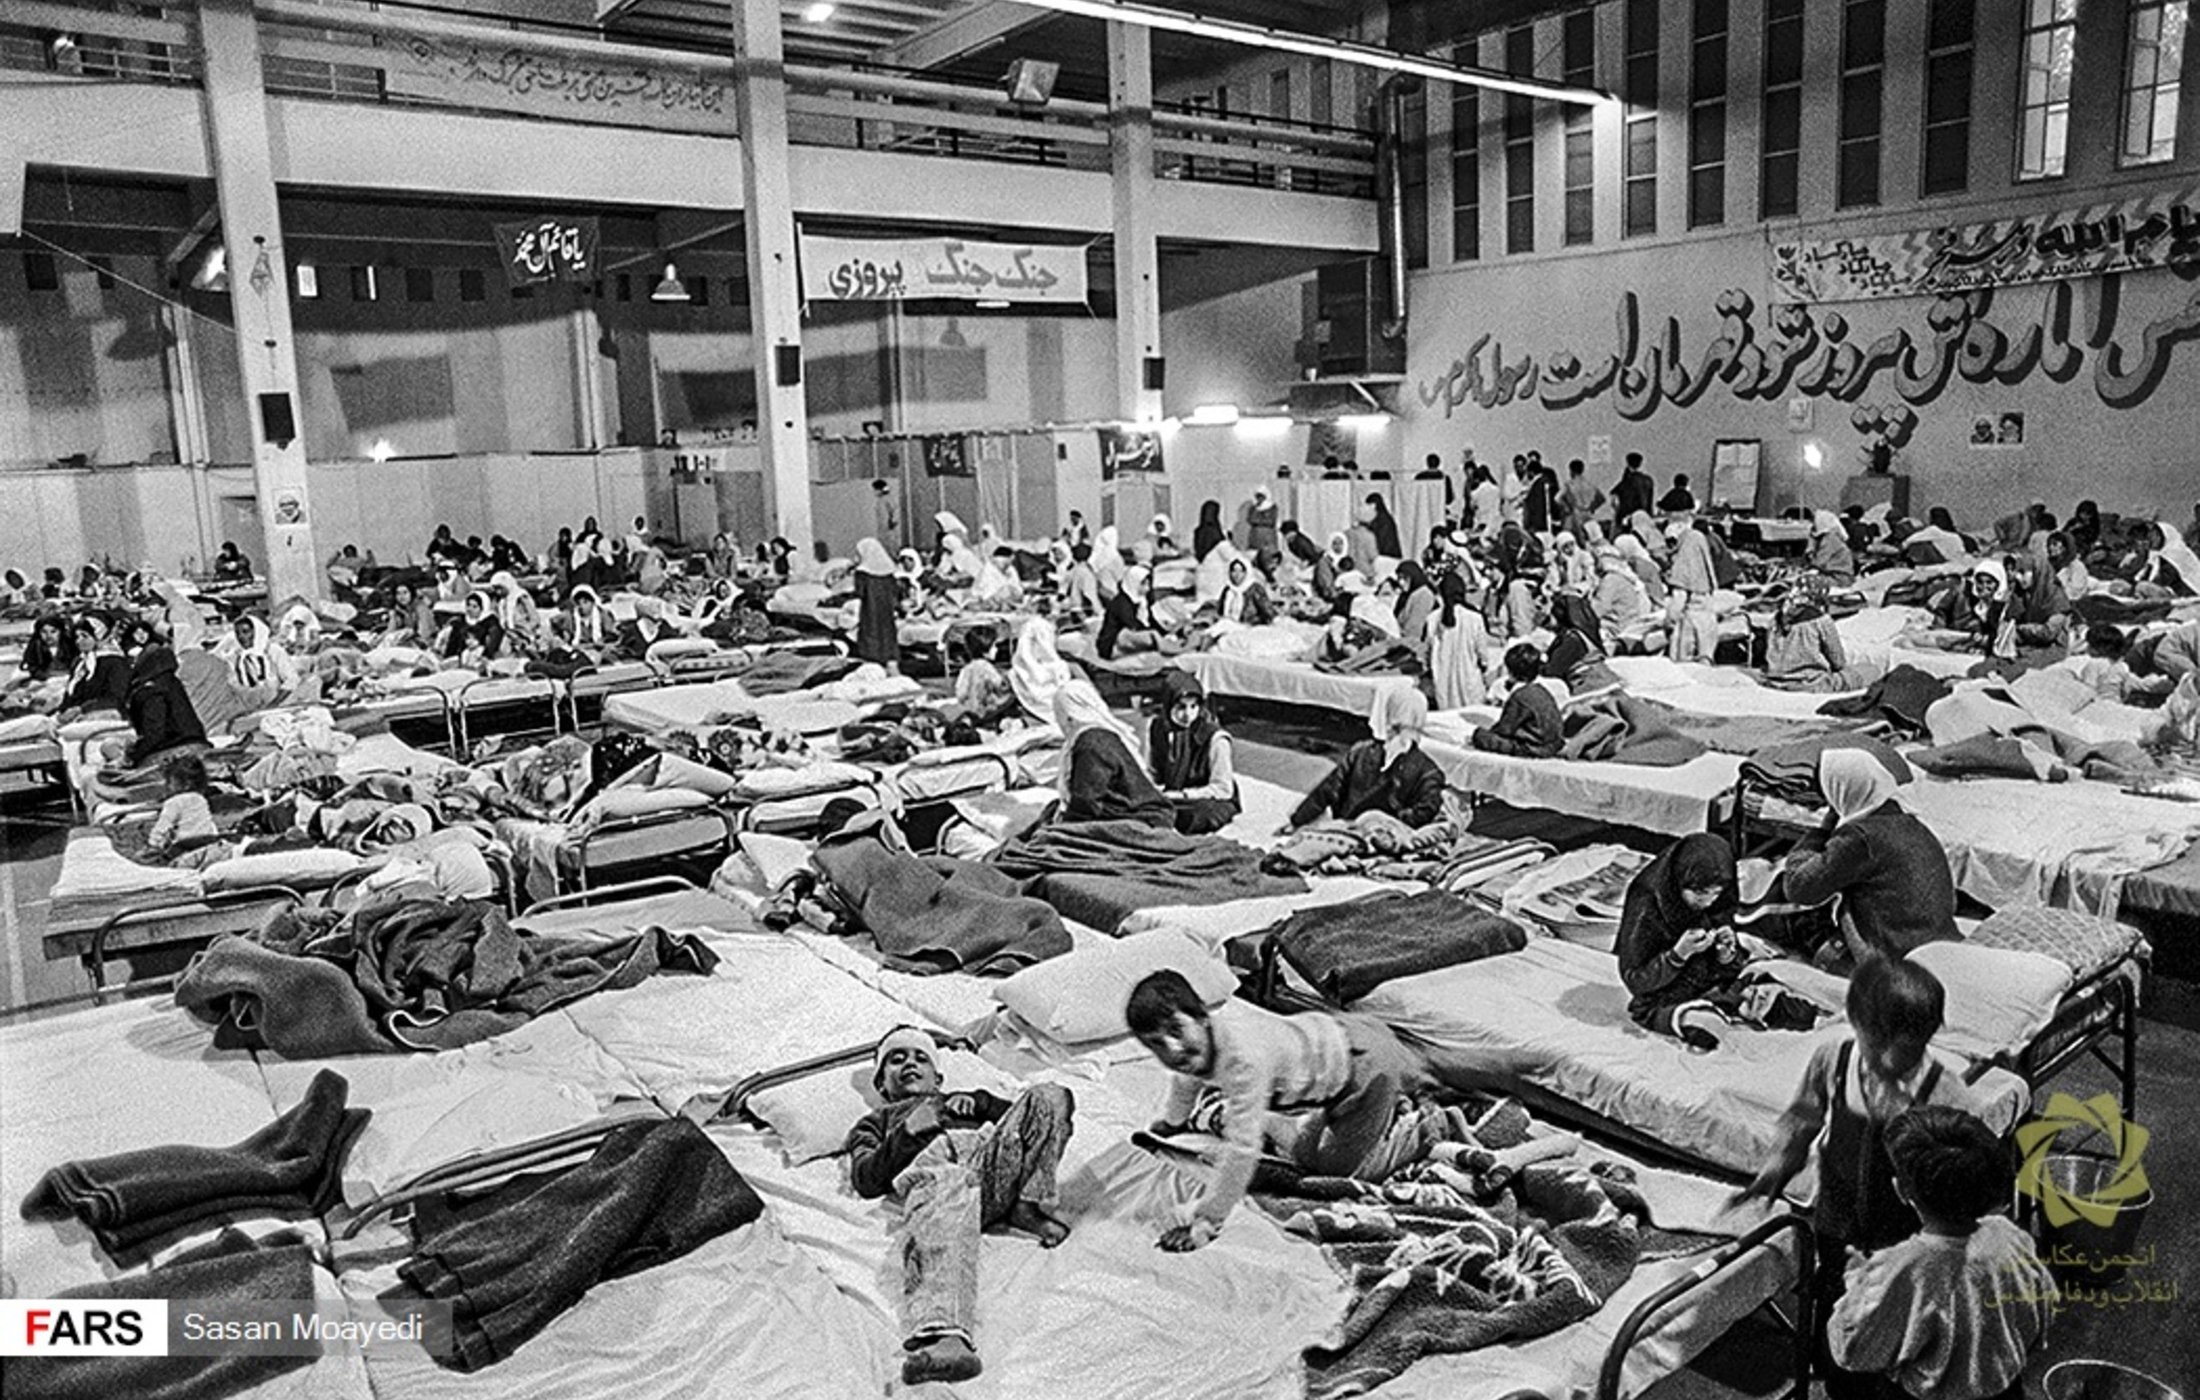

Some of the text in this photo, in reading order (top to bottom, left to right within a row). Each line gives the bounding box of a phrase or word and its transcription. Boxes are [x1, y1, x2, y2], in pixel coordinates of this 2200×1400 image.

[828, 242, 1059, 299] جنگ جنگ پیروزی
[2036, 214, 2128, 256] الله
[1538, 289, 1642, 412] است
[1612, 287, 1756, 422] قهرمان
